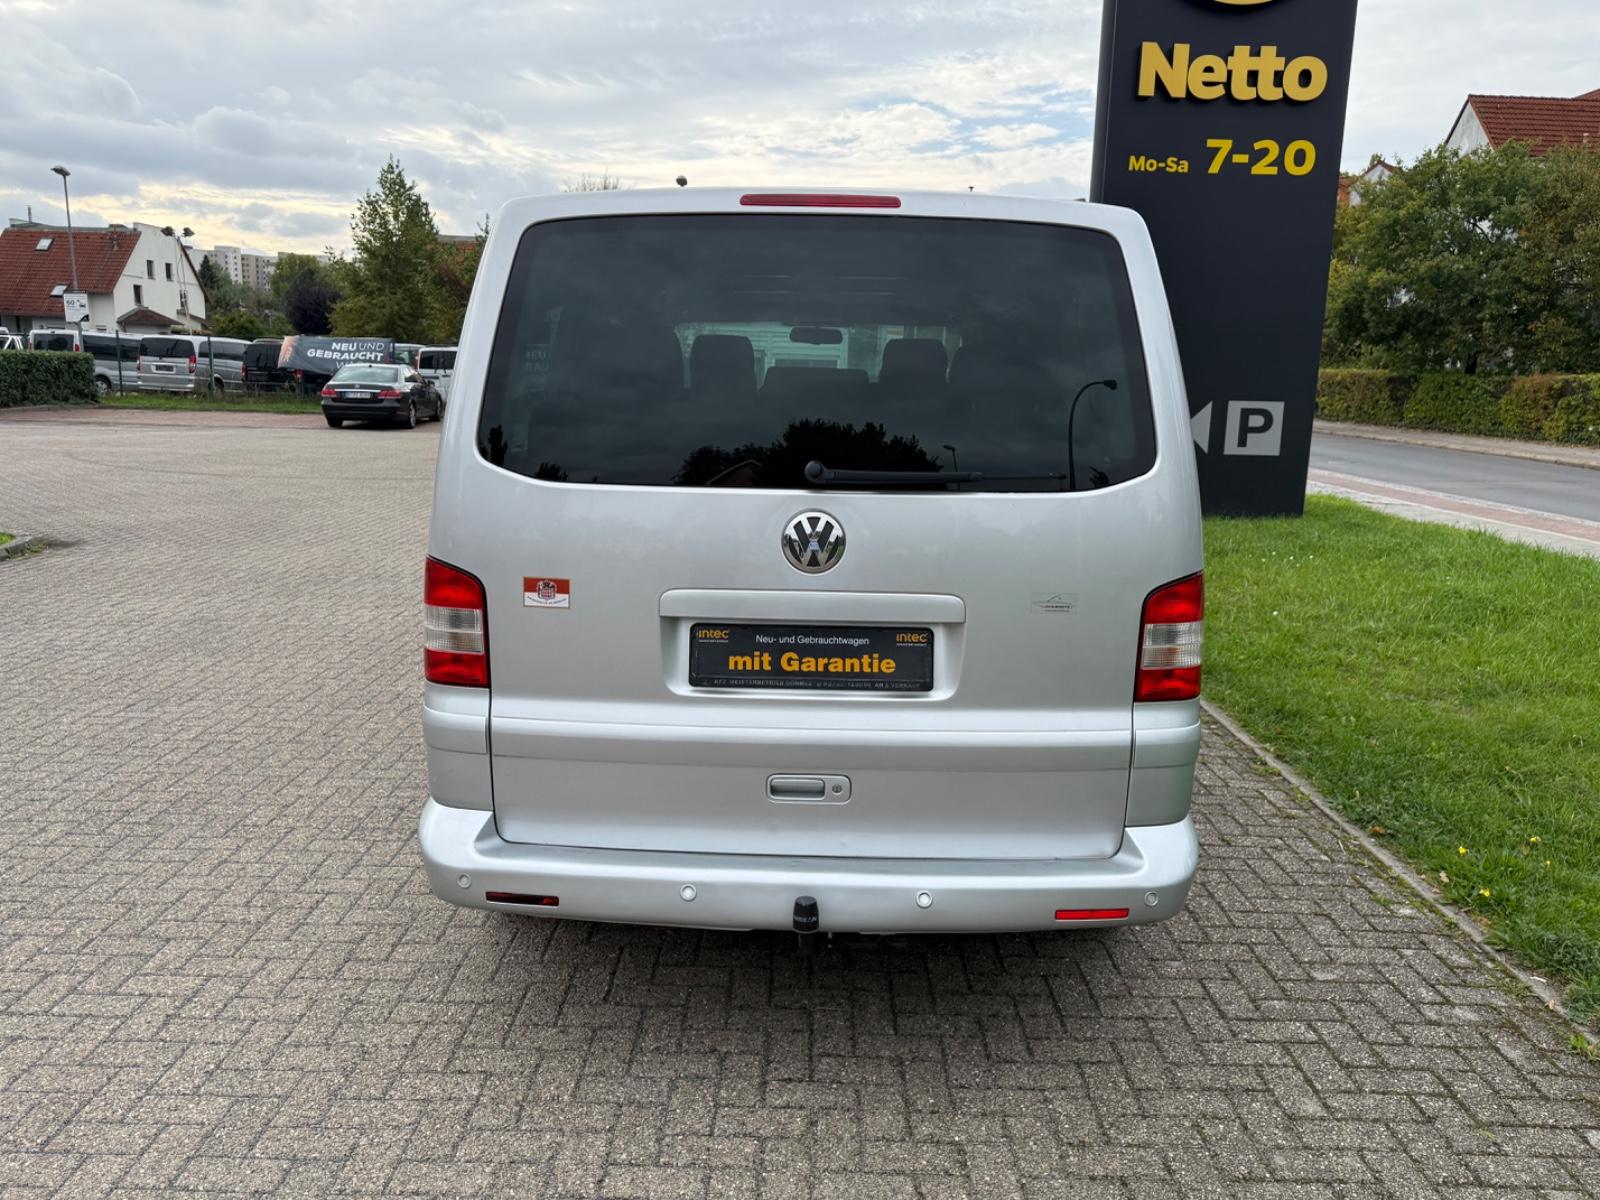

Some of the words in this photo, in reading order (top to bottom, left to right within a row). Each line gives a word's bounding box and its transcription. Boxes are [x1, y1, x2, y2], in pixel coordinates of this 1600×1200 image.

[1138, 41, 1328, 101] Netto
[1128, 155, 1189, 173] Mo-Sa
[1206, 138, 1316, 176] 7-20
[306, 348, 384, 361] GEBRAUCHT
[331, 342, 357, 351] NEU
[358, 342, 384, 351] UND
[1237, 408, 1274, 448] P
[755, 635, 777, 644] Neu-
[779, 635, 795, 644] und
[797, 635, 870, 647] Gebrauchtwagen
[896, 633, 928, 642] intec
[728, 651, 771, 671] mit
[780, 651, 896, 673] Garantie
